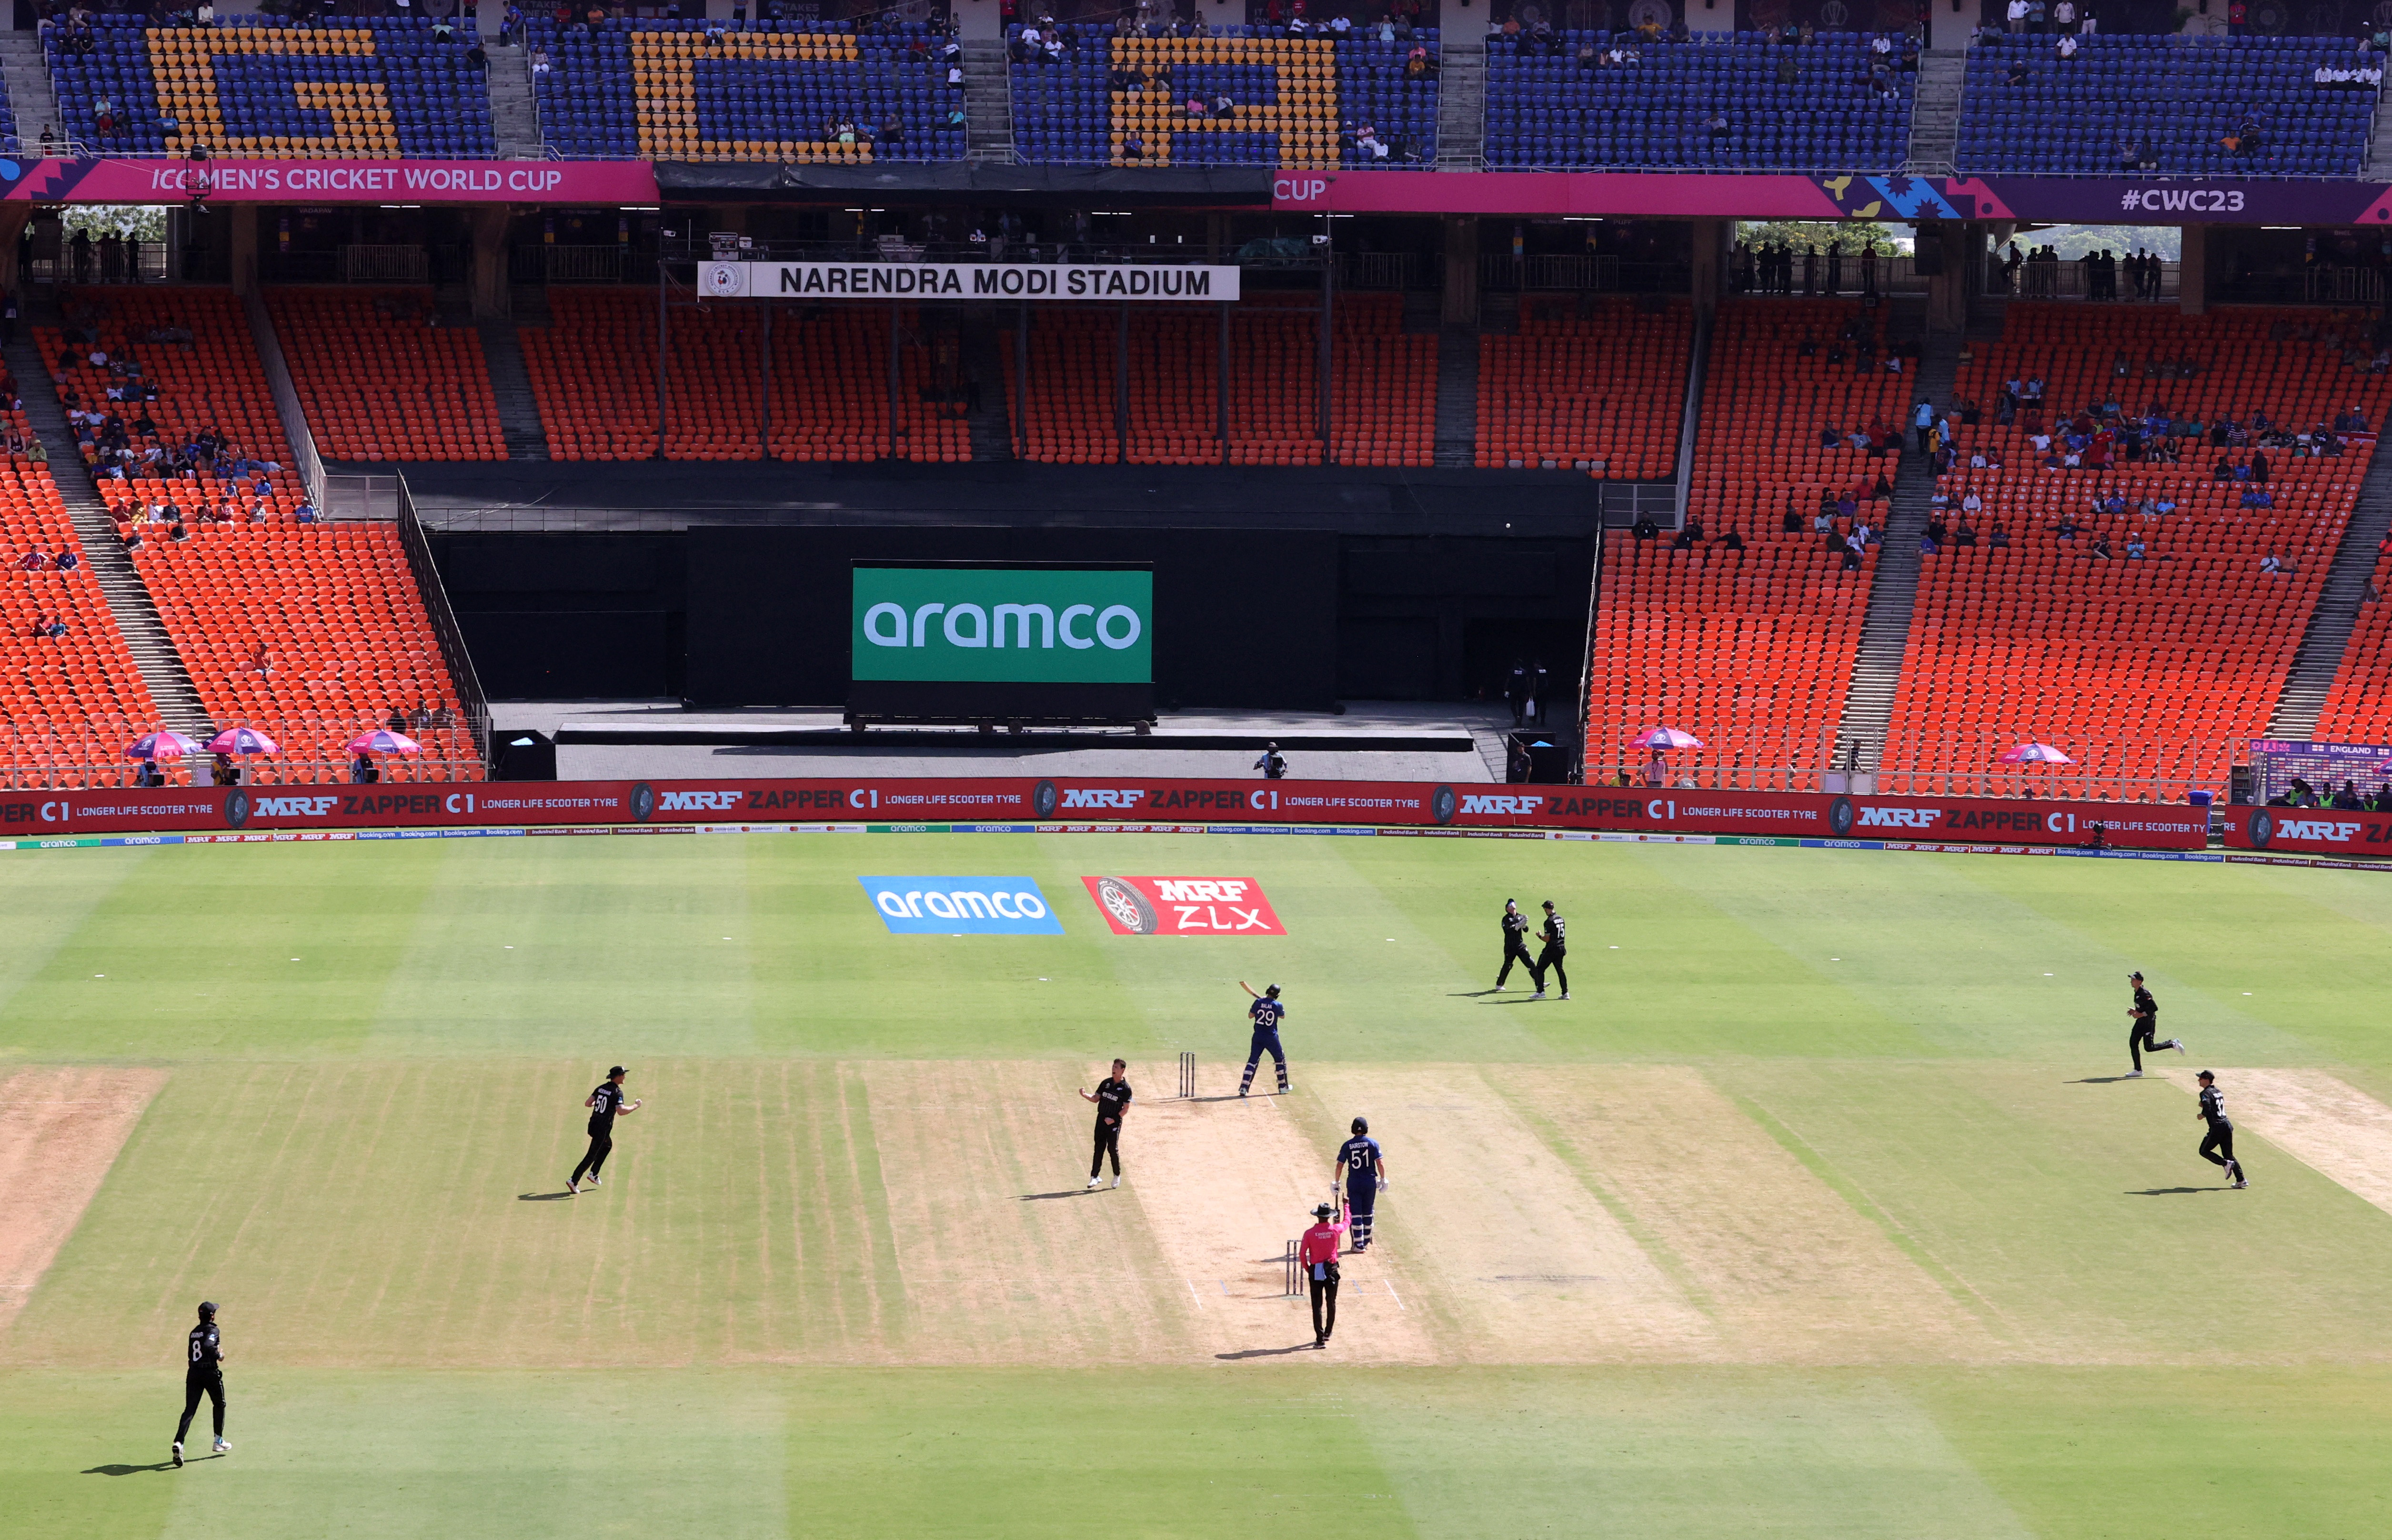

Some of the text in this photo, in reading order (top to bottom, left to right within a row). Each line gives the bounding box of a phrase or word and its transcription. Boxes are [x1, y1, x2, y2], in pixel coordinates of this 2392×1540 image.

[152, 169, 191, 190] ICC
[287, 169, 398, 190] CRICKET
[404, 169, 502, 190] WORLD
[509, 170, 561, 191] CUP
[1274, 180, 1325, 200] CUP
[2121, 190, 2244, 211] #CWC23
[781, 268, 1209, 296] NARENDRA MODI STADIUM
[864, 603, 1141, 650] aramco
[2331, 746, 2371, 754] ENGLAND
[254, 797, 337, 816] MRF
[343, 795, 441, 814] ZAPPER
[482, 800, 520, 808] LONGER
[546, 799, 590, 807] SCOOTER
[659, 791, 742, 810] MRF
[748, 790, 844, 809] ZAPPER
[1062, 790, 1144, 807] MRF
[1150, 790, 1245, 809] ZAPPER
[1348, 799, 1392, 807] SCOOTER
[1395, 800, 1419, 808] TYRE
[1460, 796, 1542, 814] MRF
[1548, 797, 1643, 818] ZAPPER
[1683, 808, 1720, 816] LONGER
[1724, 809, 1742, 817] LIFE
[1746, 810, 1789, 818] SCOOTER
[1793, 810, 1816, 819] TYRE
[0, 803, 35, 822] ER
[77, 807, 115, 816] LONGER
[141, 806, 184, 814] SCOOTER
[188, 805, 212, 813] TYRE
[1858, 808, 1940, 827] MRF
[1947, 810, 2042, 831] ZAPPER
[2146, 823, 2190, 832] SCOOTER
[2277, 820, 2360, 841] MRF
[1153, 880, 1248, 901] MRF
[877, 891, 1046, 919] aramco
[1174, 905, 1272, 930] ZLX
[1556, 923, 1565, 938] 75
[1256, 1009, 1275, 1026] 29
[594, 1095, 607, 1114] 50
[2216, 1098, 2226, 1117] 32
[1351, 1149, 1369, 1169] 51
[192, 1340, 202, 1361] 8
